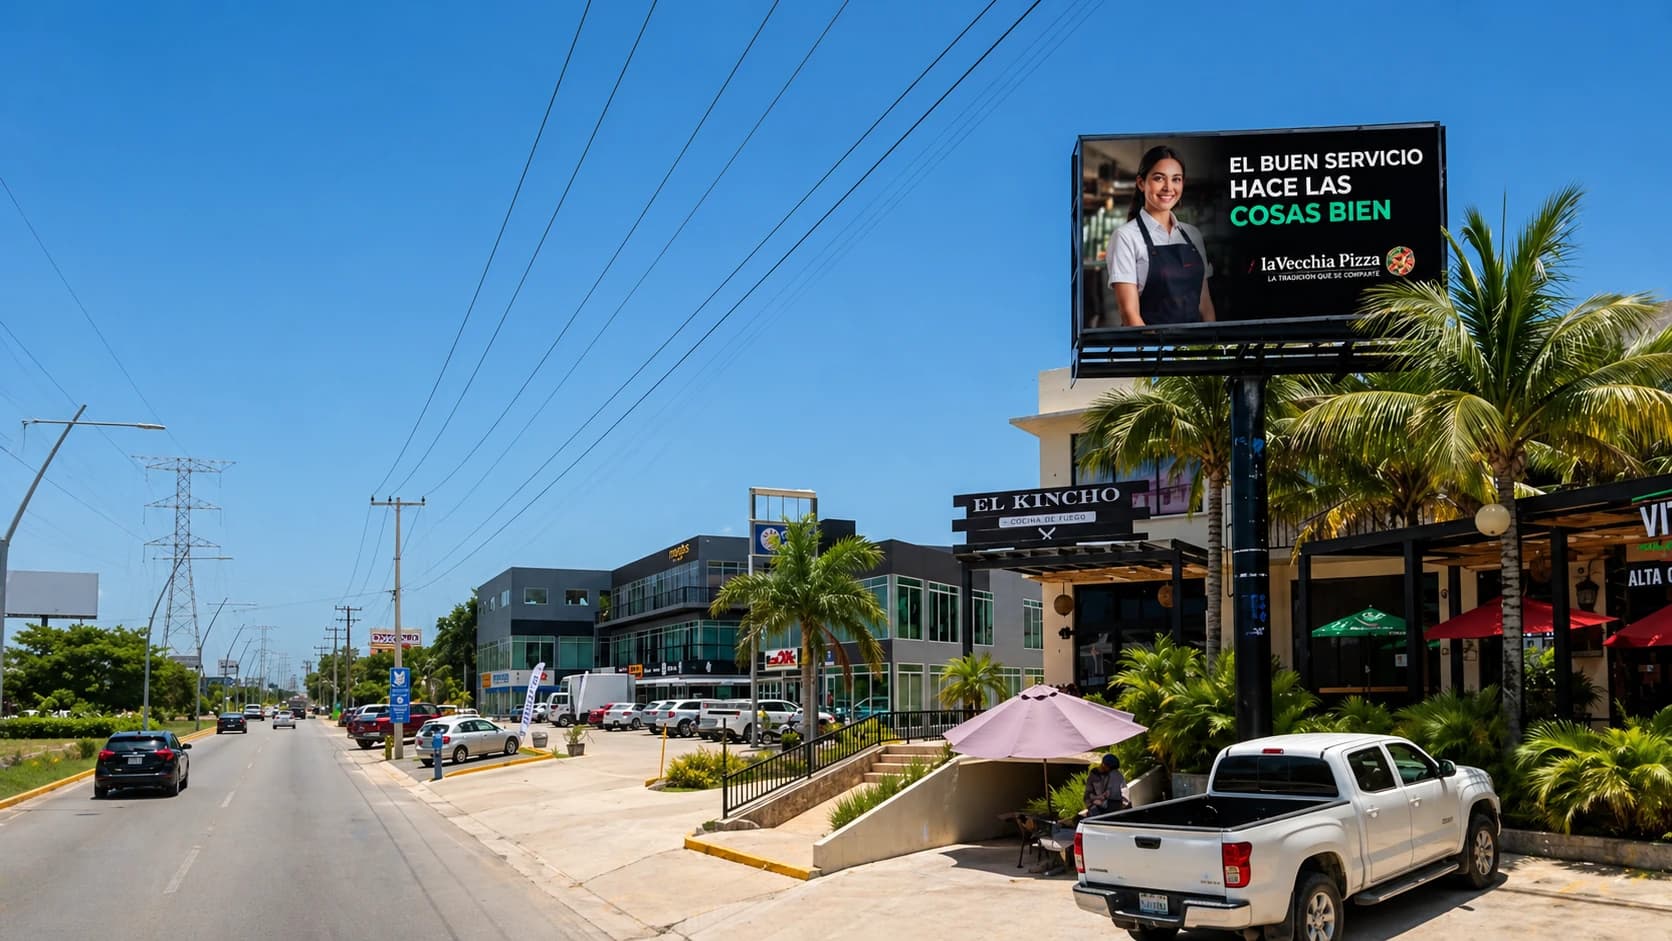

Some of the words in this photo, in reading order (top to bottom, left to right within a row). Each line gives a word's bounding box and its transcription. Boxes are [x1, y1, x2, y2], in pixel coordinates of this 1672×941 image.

[1230, 157, 1255, 173] EL
[1261, 154, 1318, 172] BUEN
[1325, 149, 1422, 168] SERVICIO
[1230, 177, 1298, 199] HACE
[1305, 174, 1352, 196] LAS
[1230, 203, 1321, 226] COSAS
[1329, 199, 1391, 222] BIEN
[1261, 254, 1336, 271] laVecchia
[1338, 252, 1381, 268] Pizza
[1317, 272, 1332, 280] QUE
[1343, 270, 1380, 279] COMPARTE
[973, 497, 1004, 512] EL
[1013, 488, 1120, 509] KINCHO
[1058, 513, 1086, 522] FUEGO
[1628, 567, 1662, 587] ALTA
